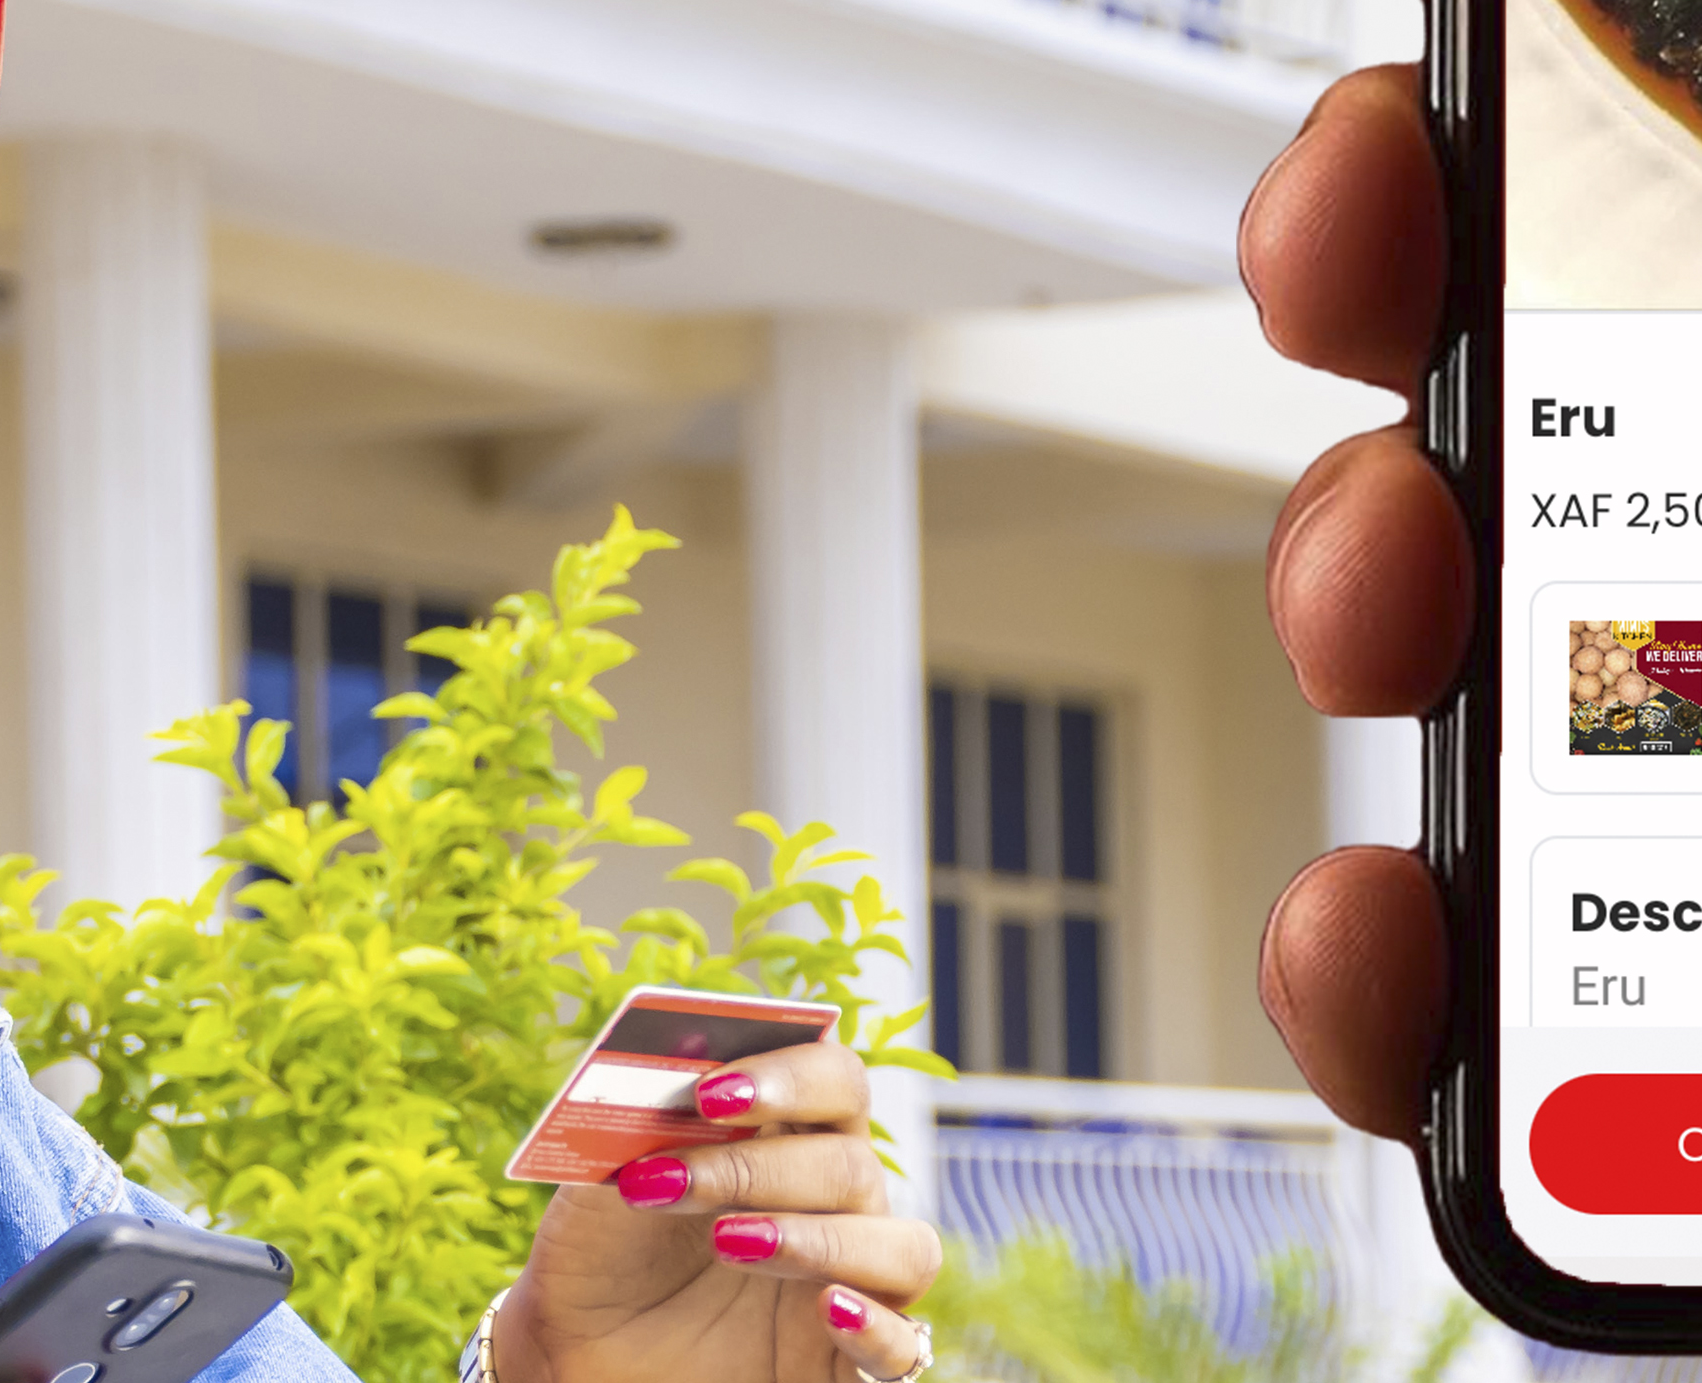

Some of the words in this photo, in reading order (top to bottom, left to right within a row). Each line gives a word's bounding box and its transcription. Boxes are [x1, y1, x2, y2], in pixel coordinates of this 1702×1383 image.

[1531, 397, 1616, 438] Eru
[1531, 493, 1613, 528] XAF
[1573, 966, 1645, 1006] Eru
